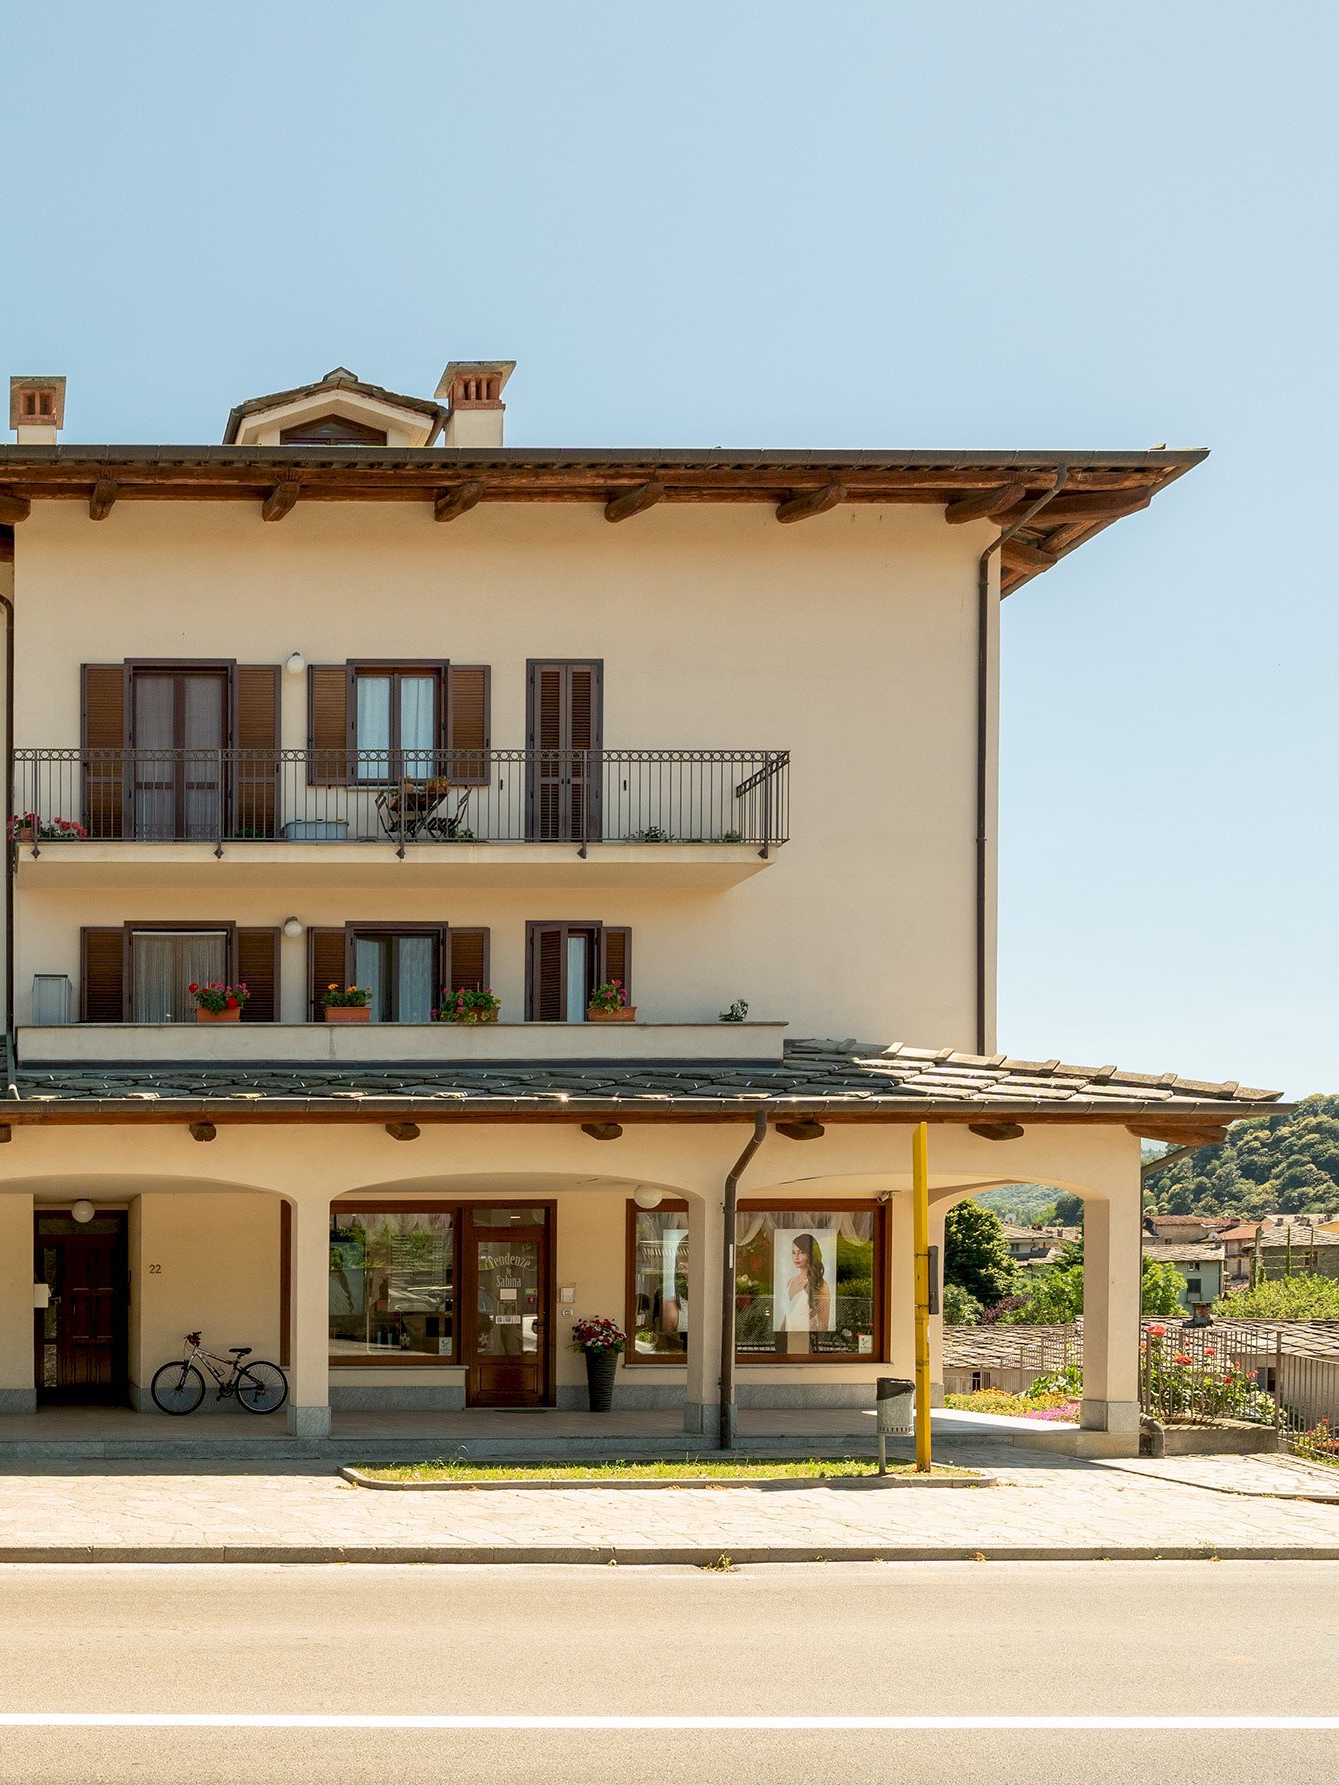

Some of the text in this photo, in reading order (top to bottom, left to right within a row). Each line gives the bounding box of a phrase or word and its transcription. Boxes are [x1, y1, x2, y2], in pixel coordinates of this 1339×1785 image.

[485, 1252, 531, 1269] Tendenze
[149, 1264, 162, 1274] 22
[496, 1275, 522, 1287] Sabina
